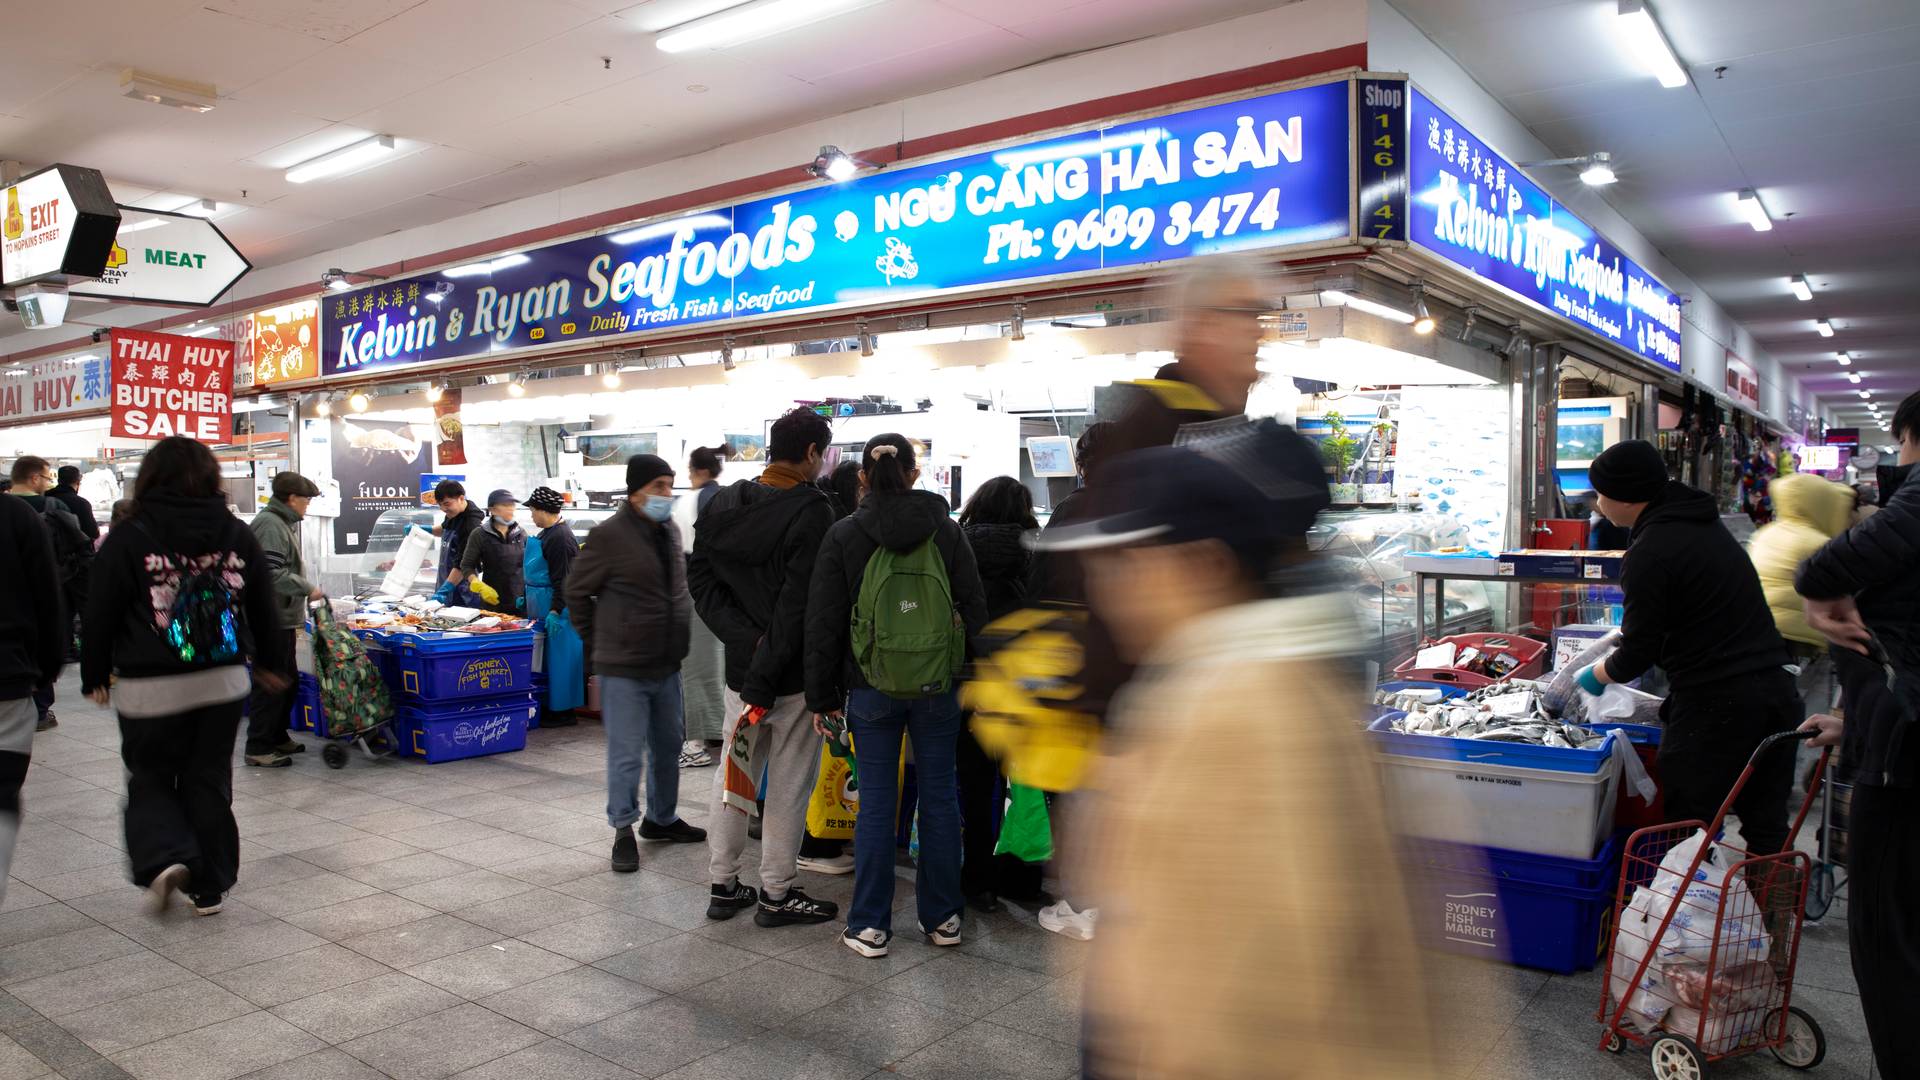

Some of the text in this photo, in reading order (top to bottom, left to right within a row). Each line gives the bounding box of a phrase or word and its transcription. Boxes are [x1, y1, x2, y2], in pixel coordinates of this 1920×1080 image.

[1365, 85, 1402, 109] Shop
[30, 198, 59, 232] EXIT
[984, 188, 1281, 265] Ph: 9689 3474
[5, 229, 60, 255] TO HOPKINS STREET
[145, 248, 207, 270] MEAT
[335, 200, 818, 370] Kelvin & Ryan Seafoods
[1568, 243, 1624, 306] Seafoods
[589, 310, 630, 332] Daily
[632, 303, 679, 326] Fresh
[681, 295, 721, 319] Fish
[736, 280, 815, 312] Seafood
[220, 319, 253, 343] SHOP
[562, 324, 575, 333] 147
[117, 338, 231, 368] THAI HUY
[33, 375, 76, 412] HUY
[116, 383, 228, 414] BUTCHER
[123, 410, 220, 440] SALE
[358, 482, 409, 498] HUON
[461, 669, 509, 683] FISH MARKET
[468, 659, 500, 673] SYDNEY
[1495, 778, 1522, 787] SEAFOODS
[1445, 902, 1496, 919] SYDNEY
[1445, 912, 1473, 925] FISH
[1445, 922, 1496, 939] MARKET
